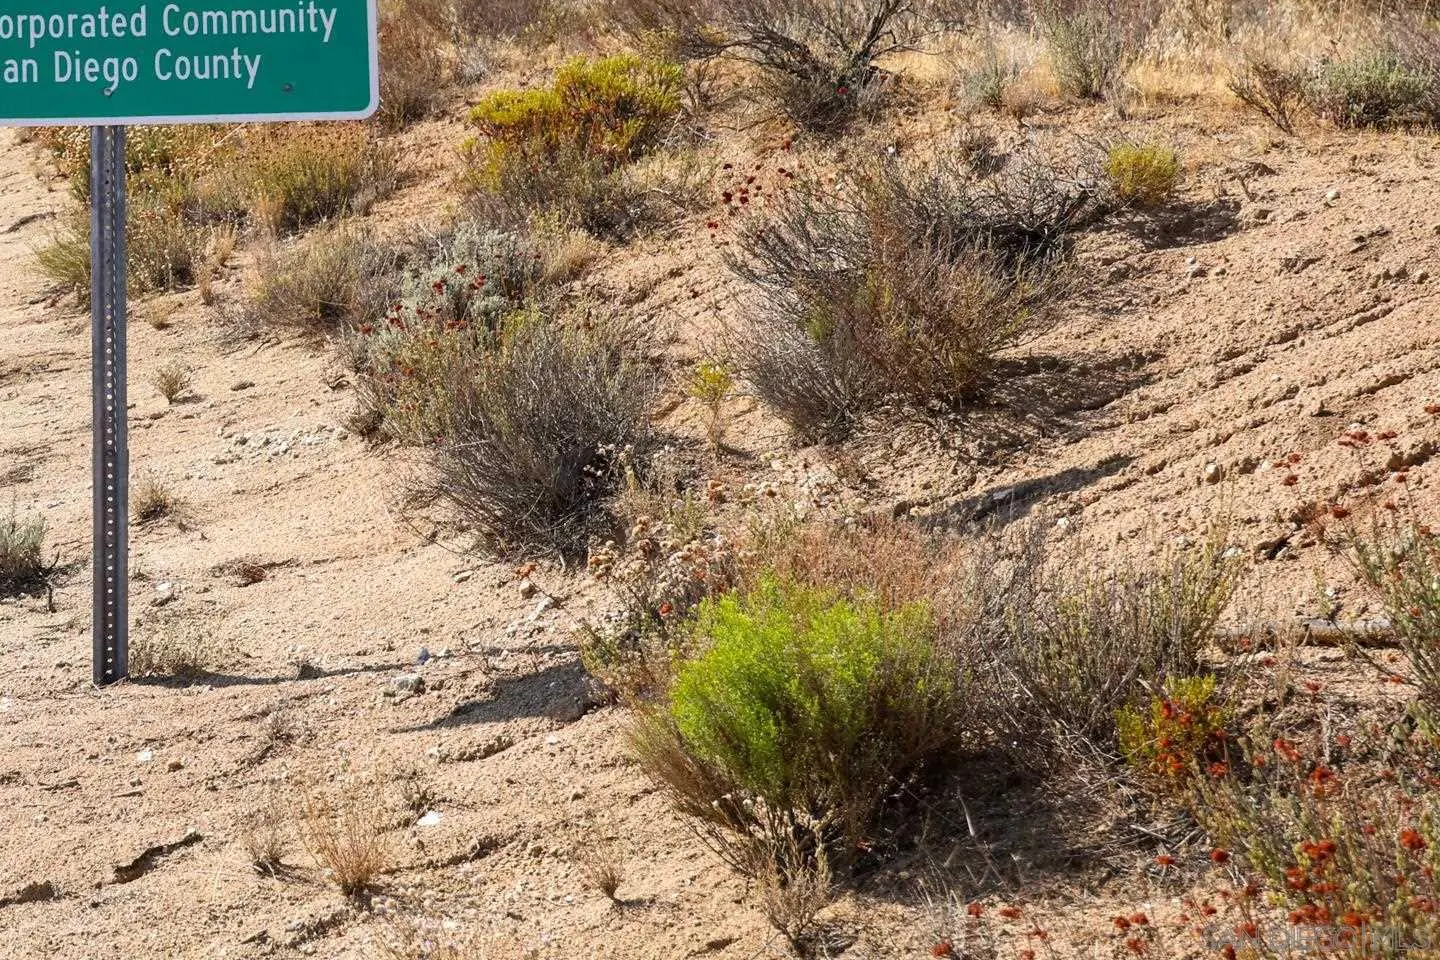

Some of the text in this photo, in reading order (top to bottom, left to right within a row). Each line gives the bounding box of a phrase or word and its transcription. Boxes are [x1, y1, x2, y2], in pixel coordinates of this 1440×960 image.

[164, 2, 336, 42] Community
[55, 51, 137, 92] Diego
[155, 48, 260, 88] County
